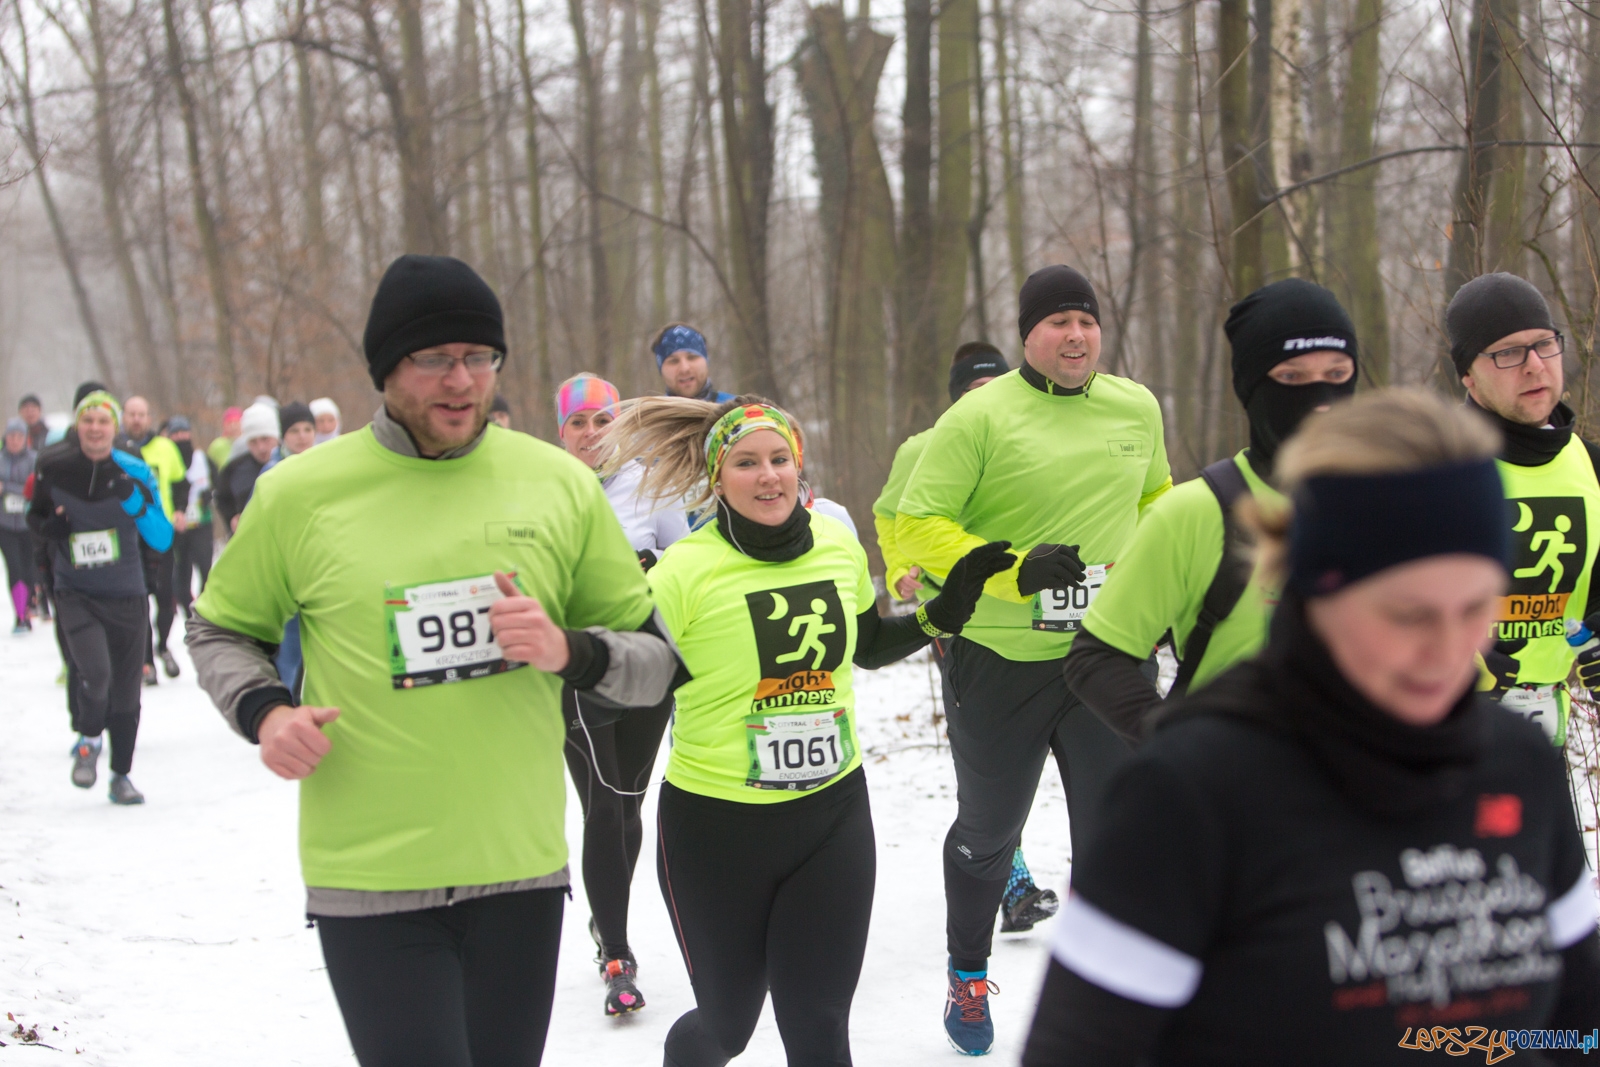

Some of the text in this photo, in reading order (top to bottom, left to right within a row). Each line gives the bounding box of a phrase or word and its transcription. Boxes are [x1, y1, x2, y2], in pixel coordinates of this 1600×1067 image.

[80, 541, 107, 558] 164
[752, 689, 836, 714] runners
[768, 734, 838, 770] 1061
[778, 768, 830, 780] ENDOWOMAN
